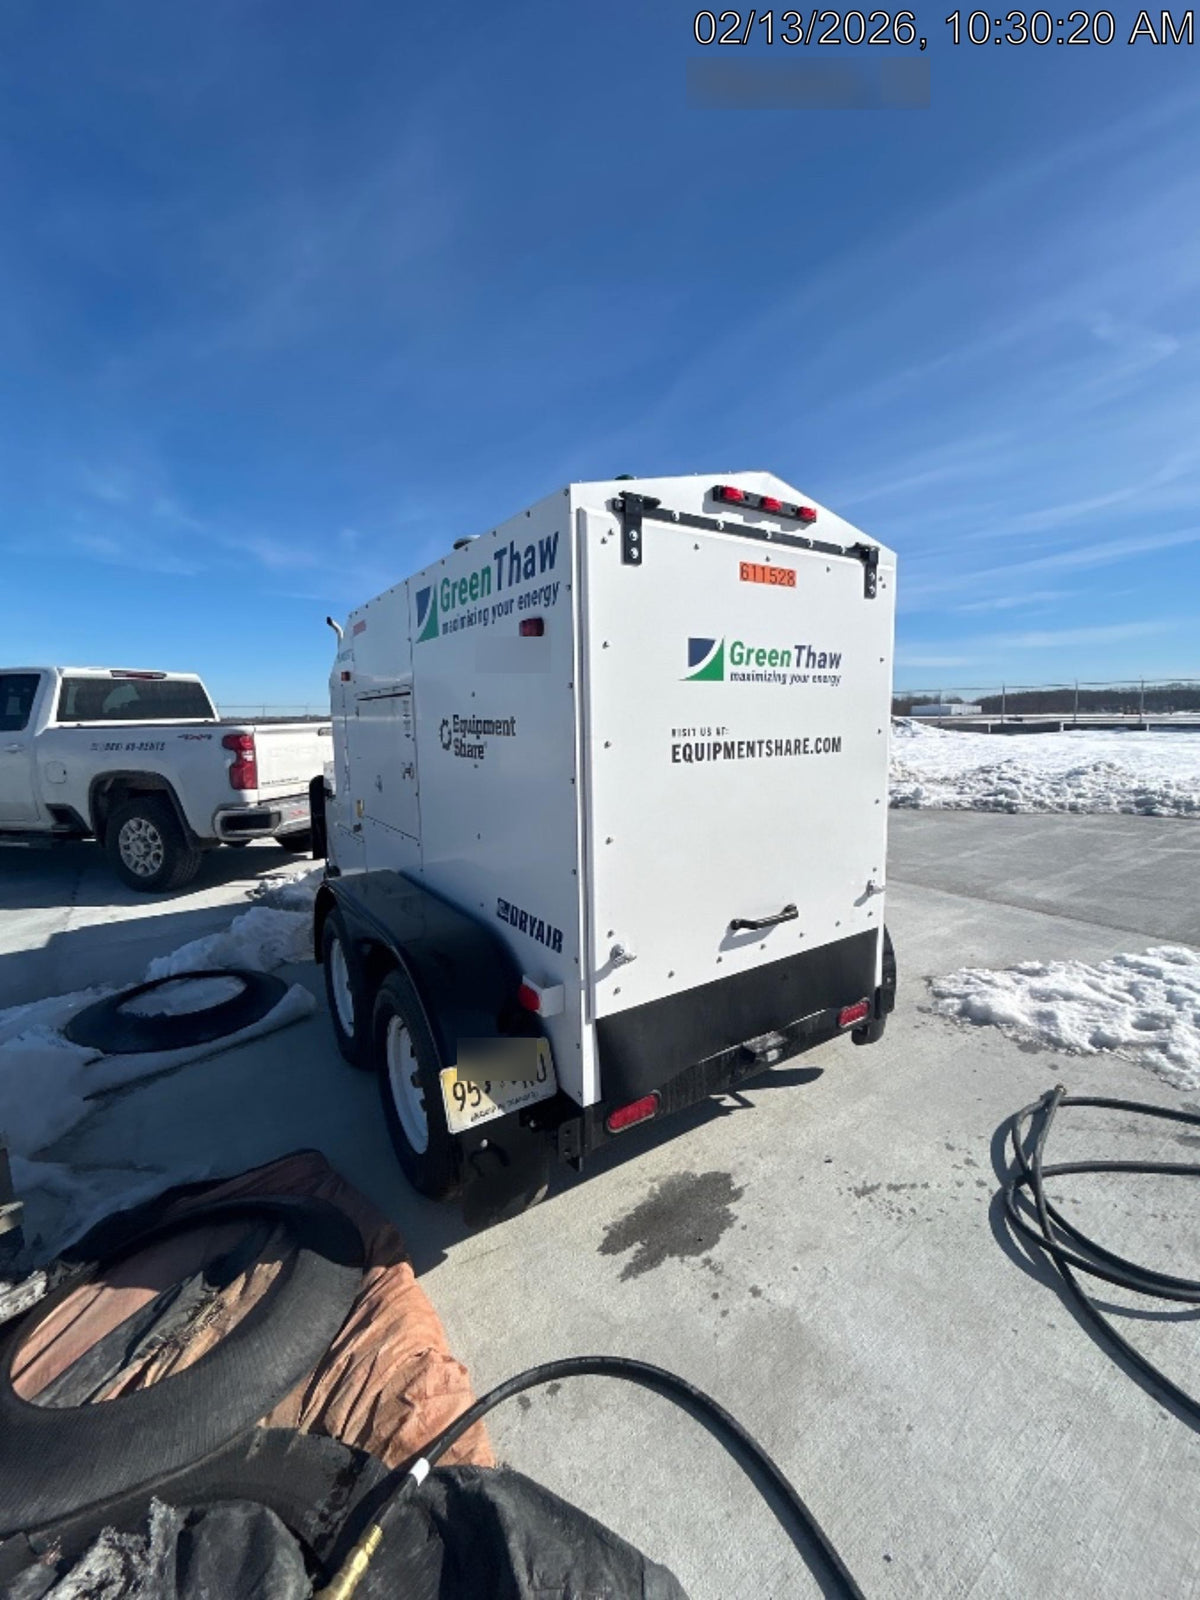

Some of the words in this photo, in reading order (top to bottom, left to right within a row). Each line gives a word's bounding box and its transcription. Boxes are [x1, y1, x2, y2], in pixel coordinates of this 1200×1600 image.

[739, 563, 796, 587] 611528
[442, 608, 490, 635] maximizing
[491, 598, 514, 624] your
[518, 581, 560, 610] energy
[730, 670, 787, 685] maximizing
[789, 674, 810, 686] your
[812, 674, 841, 687] energy
[452, 714, 516, 739] Equipment
[672, 728, 696, 738] VISIT
[700, 727, 712, 737] US
[453, 738, 485, 760] Share
[672, 736, 842, 764] EQUIPMENTSHARE.COM
[509, 904, 563, 953] DRYAIR
